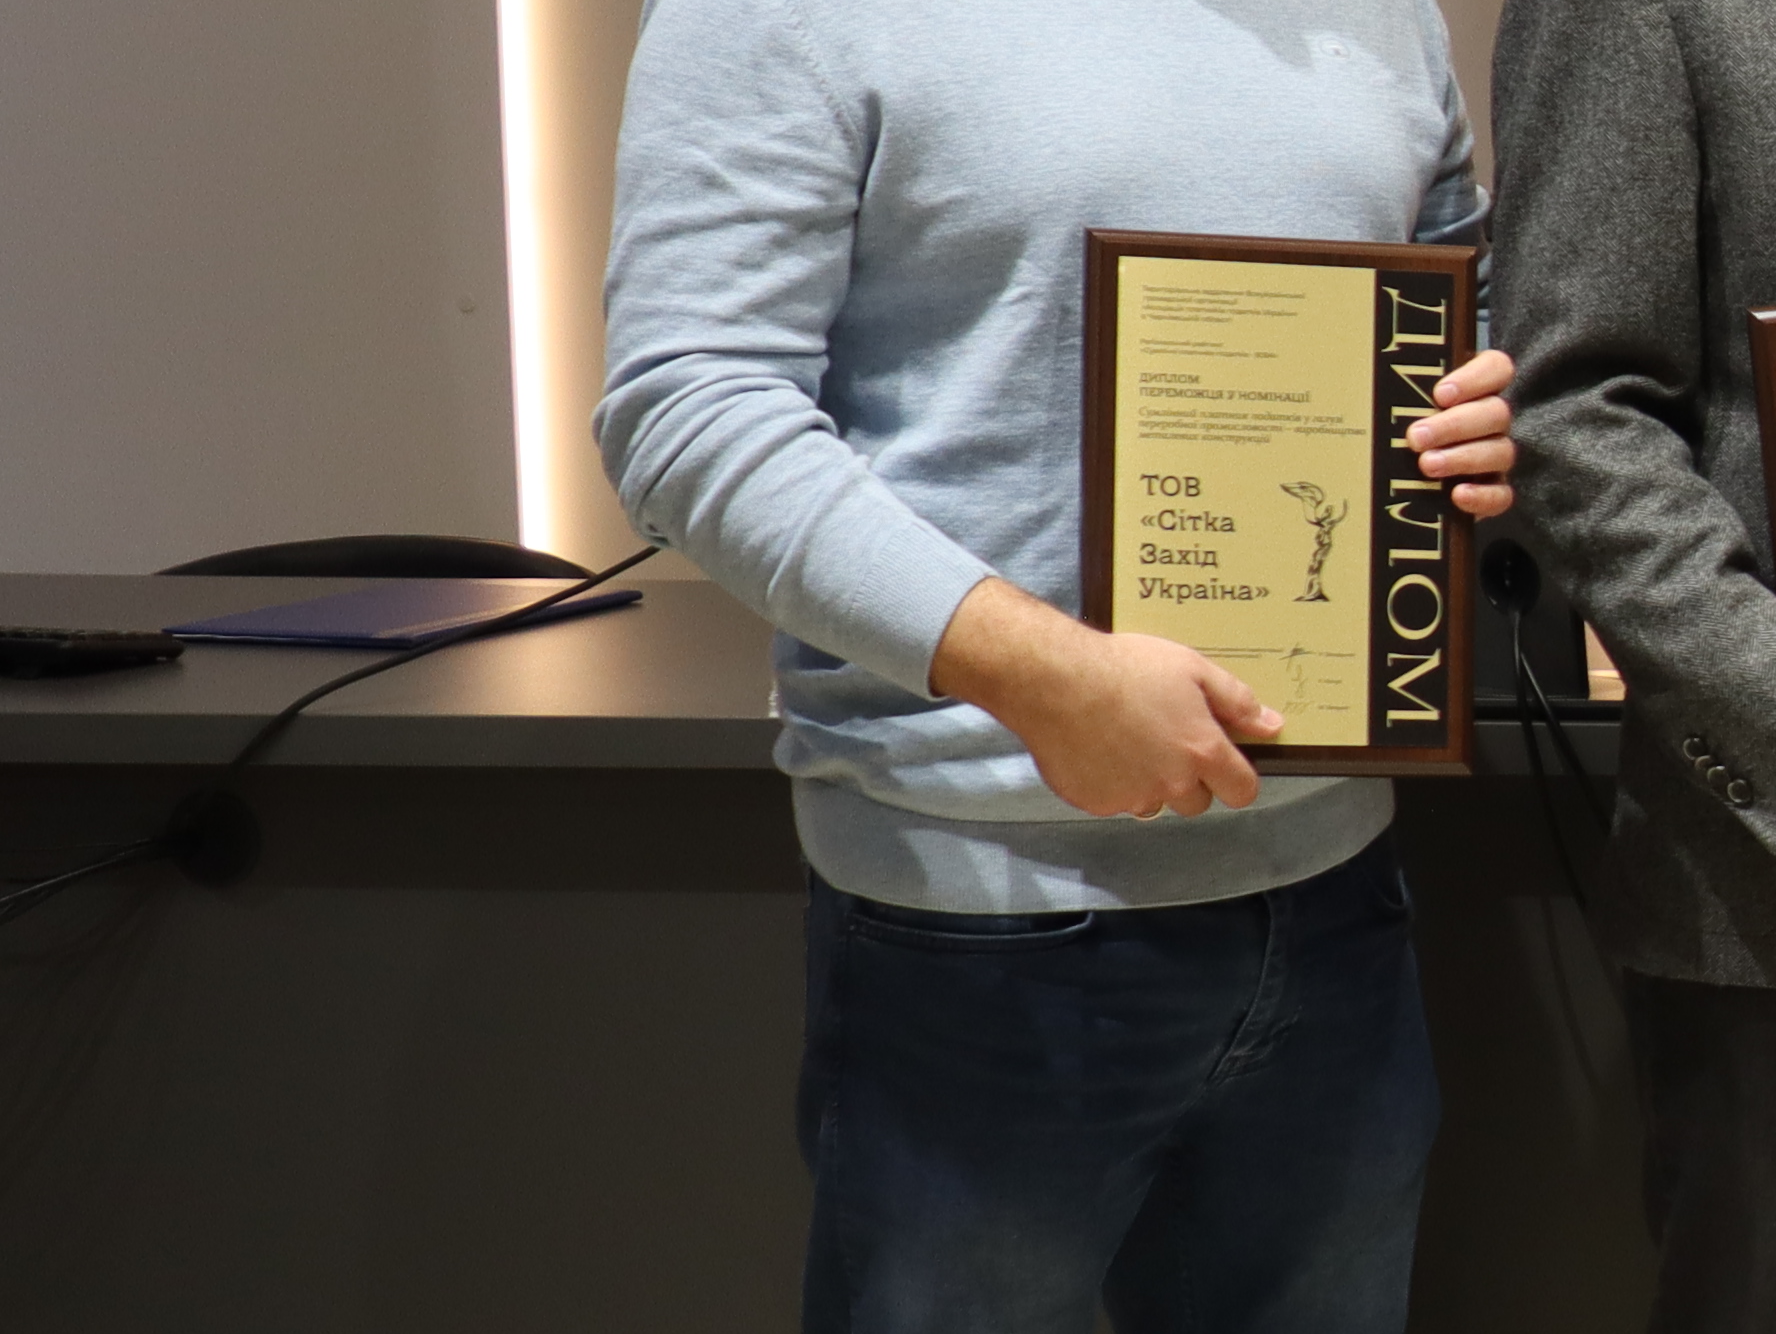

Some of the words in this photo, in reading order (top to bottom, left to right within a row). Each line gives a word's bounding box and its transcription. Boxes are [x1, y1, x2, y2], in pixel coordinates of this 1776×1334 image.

[1139, 372, 1199, 383] ДИПЛОМ
[1139, 473, 1200, 497] ТОВ
[1140, 509, 1235, 532] «Сітка
[1139, 542, 1218, 567] Захід
[1138, 577, 1269, 603] Україна»
